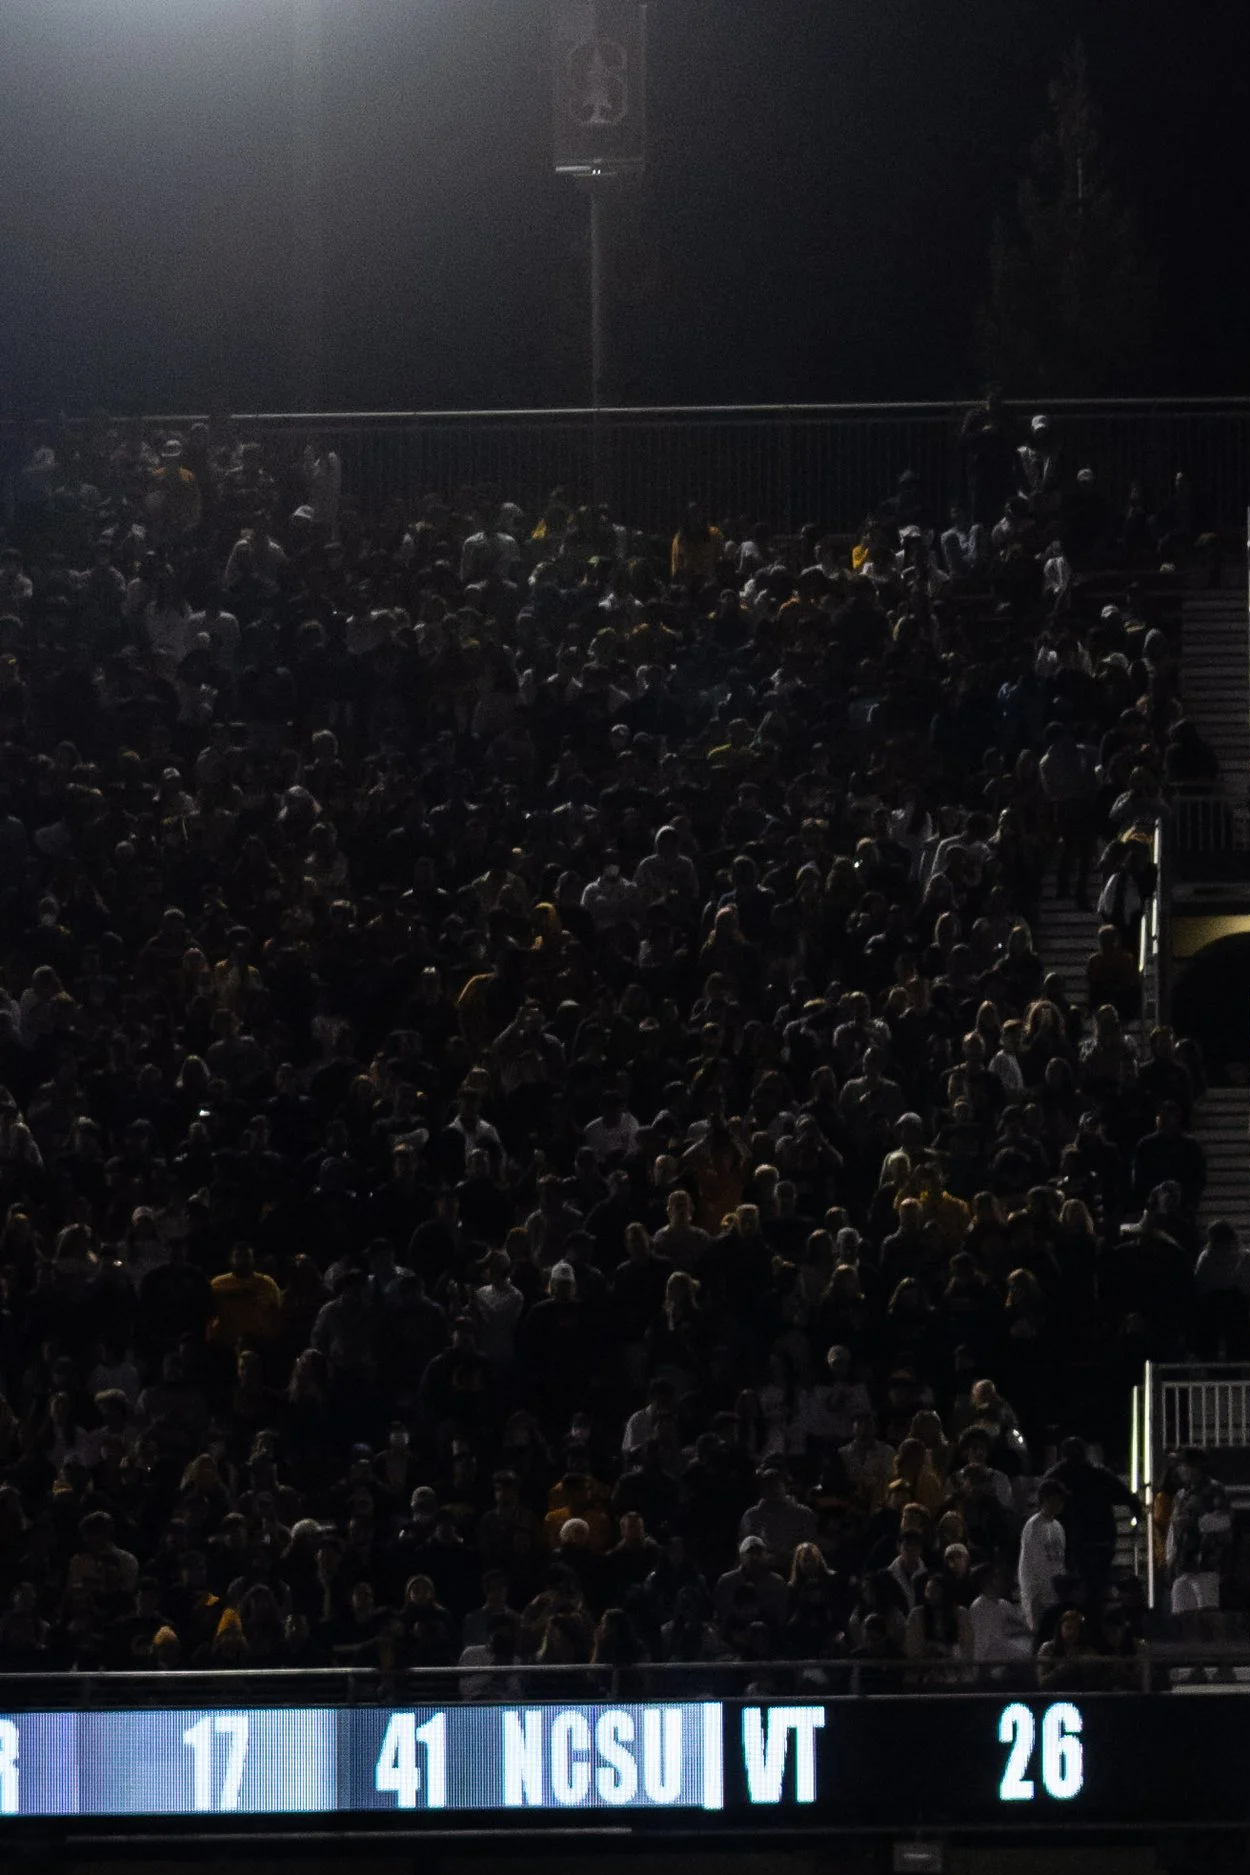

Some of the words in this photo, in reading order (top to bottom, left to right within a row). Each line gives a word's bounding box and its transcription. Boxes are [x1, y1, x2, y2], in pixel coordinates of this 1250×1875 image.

[183, 1714, 249, 1810] 17
[376, 1713, 446, 1806] 41
[503, 1707, 683, 1805] NCSU
[745, 1707, 824, 1801] VT
[1000, 1704, 1082, 1798] 26
